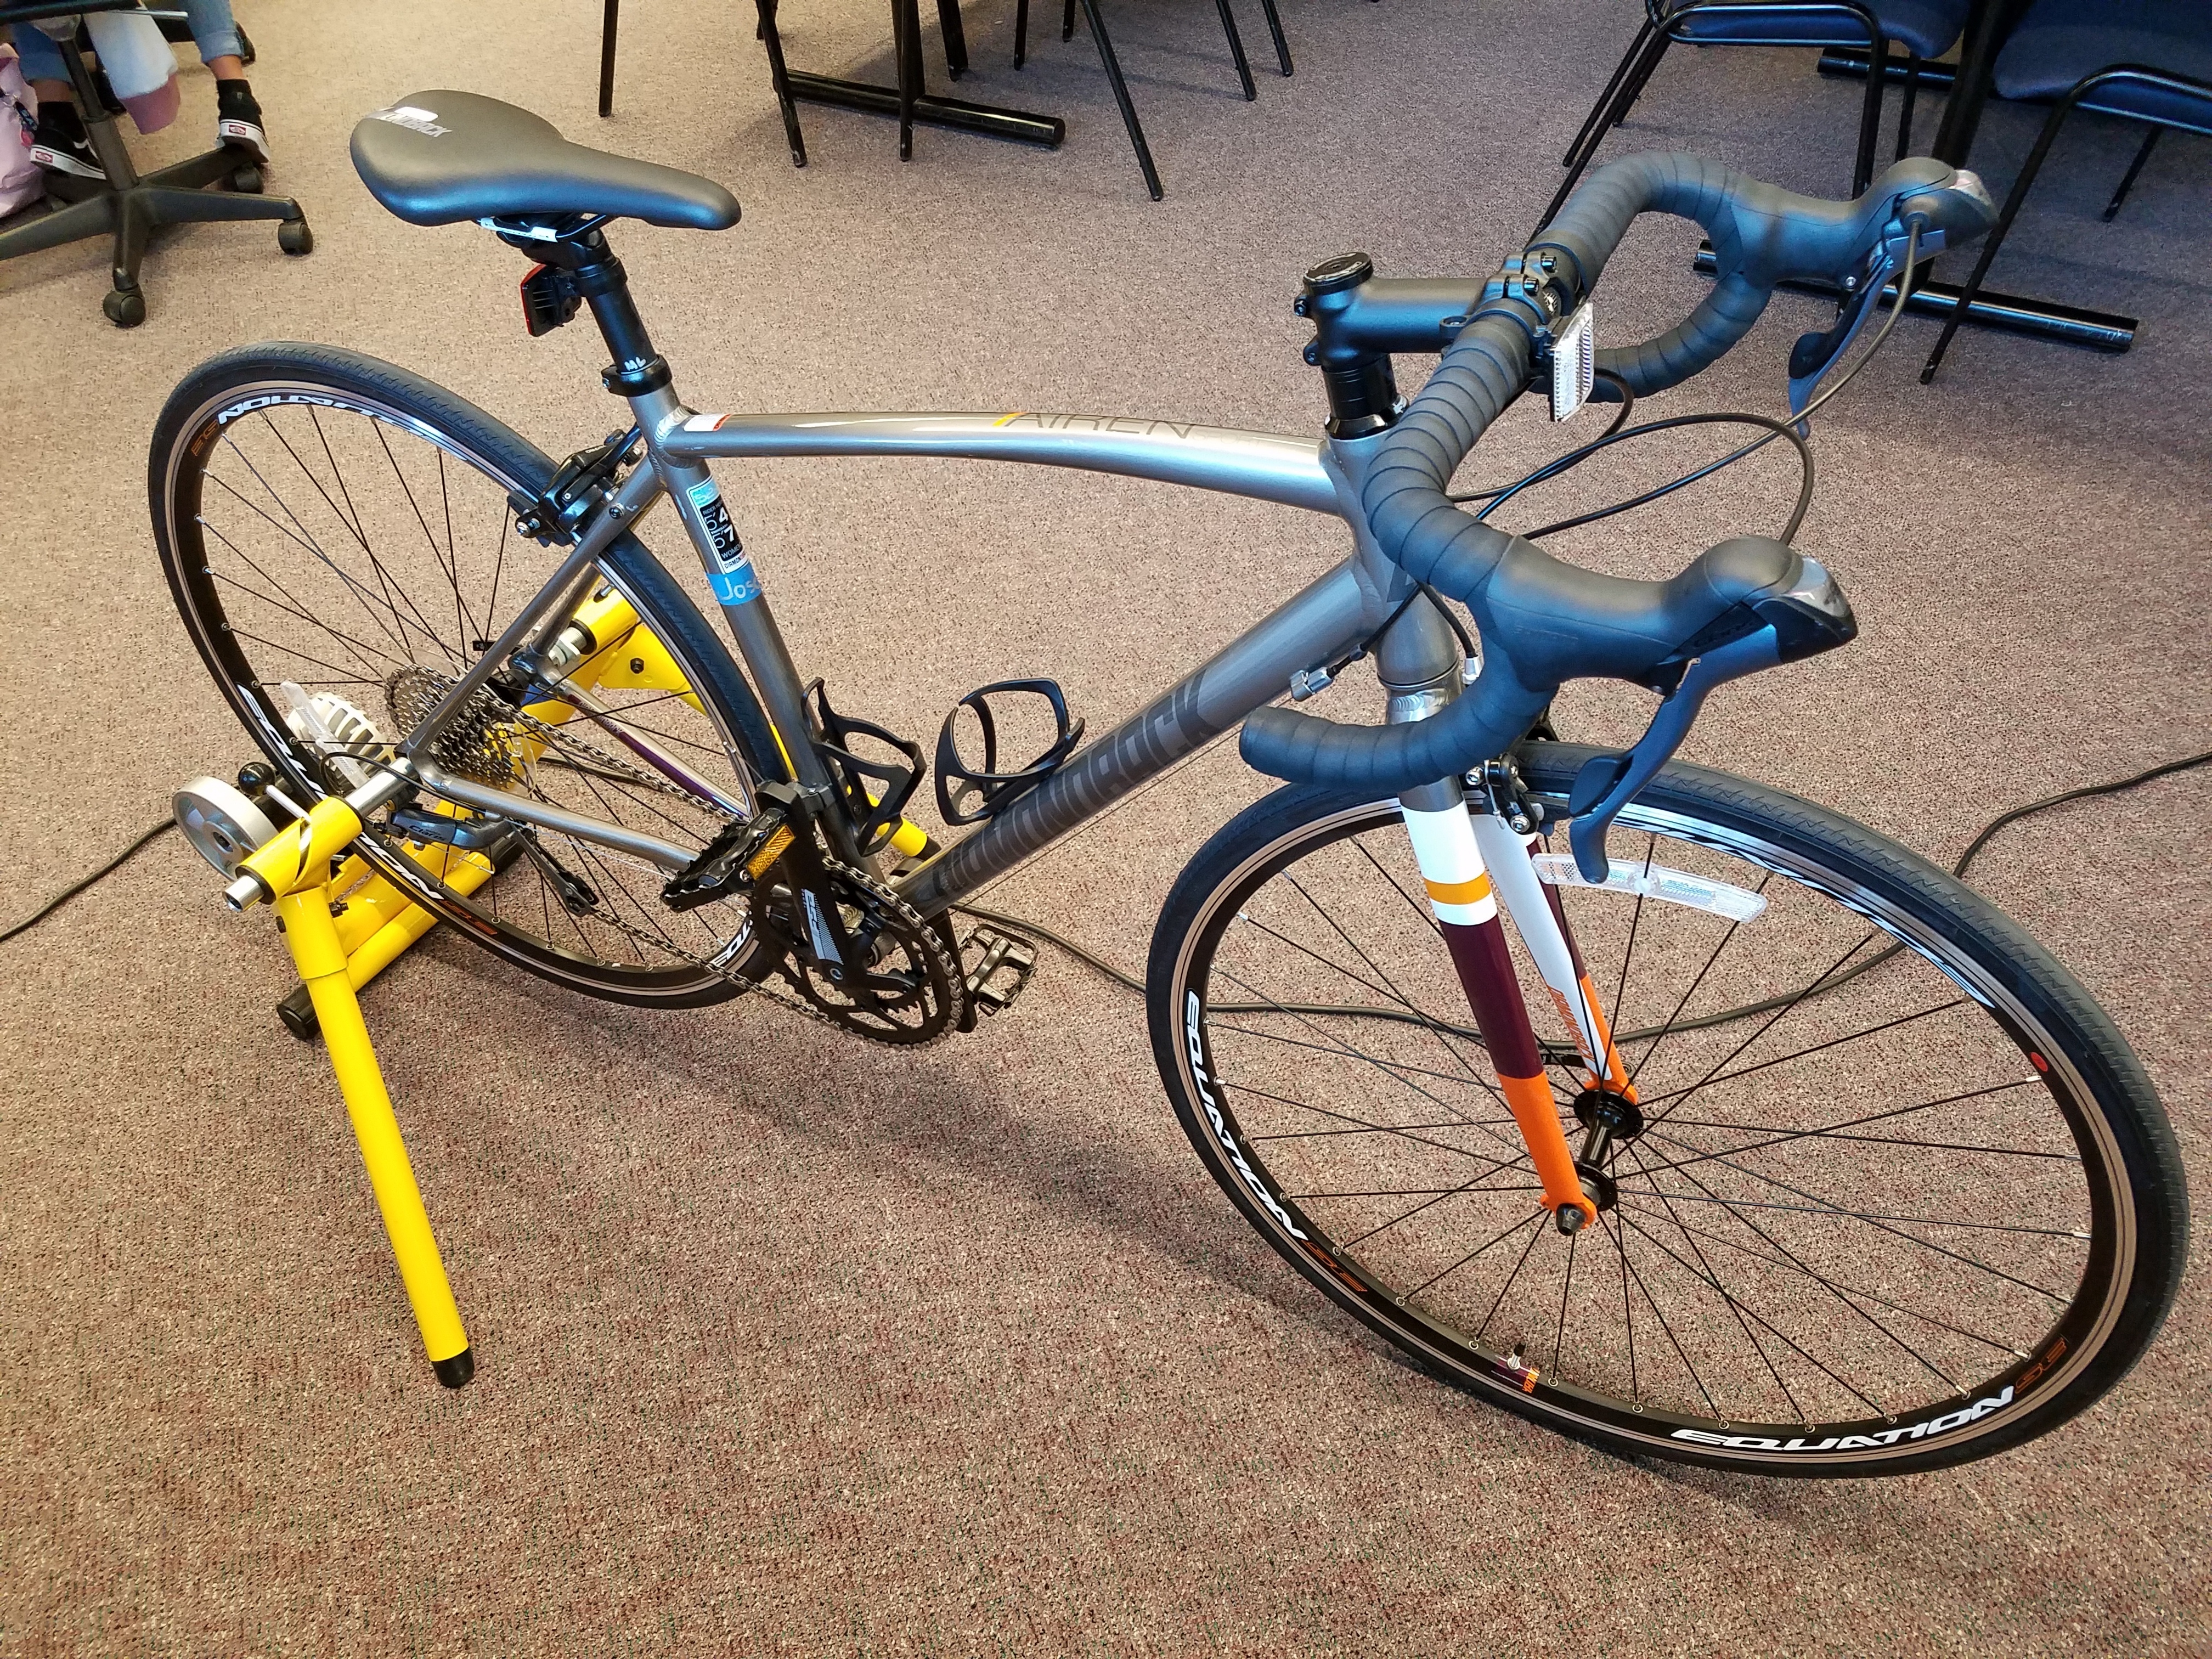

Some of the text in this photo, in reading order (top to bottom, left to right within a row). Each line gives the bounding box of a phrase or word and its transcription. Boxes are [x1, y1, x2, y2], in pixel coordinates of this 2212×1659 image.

[1005, 412, 1195, 439] AIREN
[236, 684, 445, 900] EQUION
[1611, 817, 1996, 1008] EQUATIO
[1186, 990, 1309, 1241] EQUATION
[1670, 1385, 2015, 1452] EQUATION
